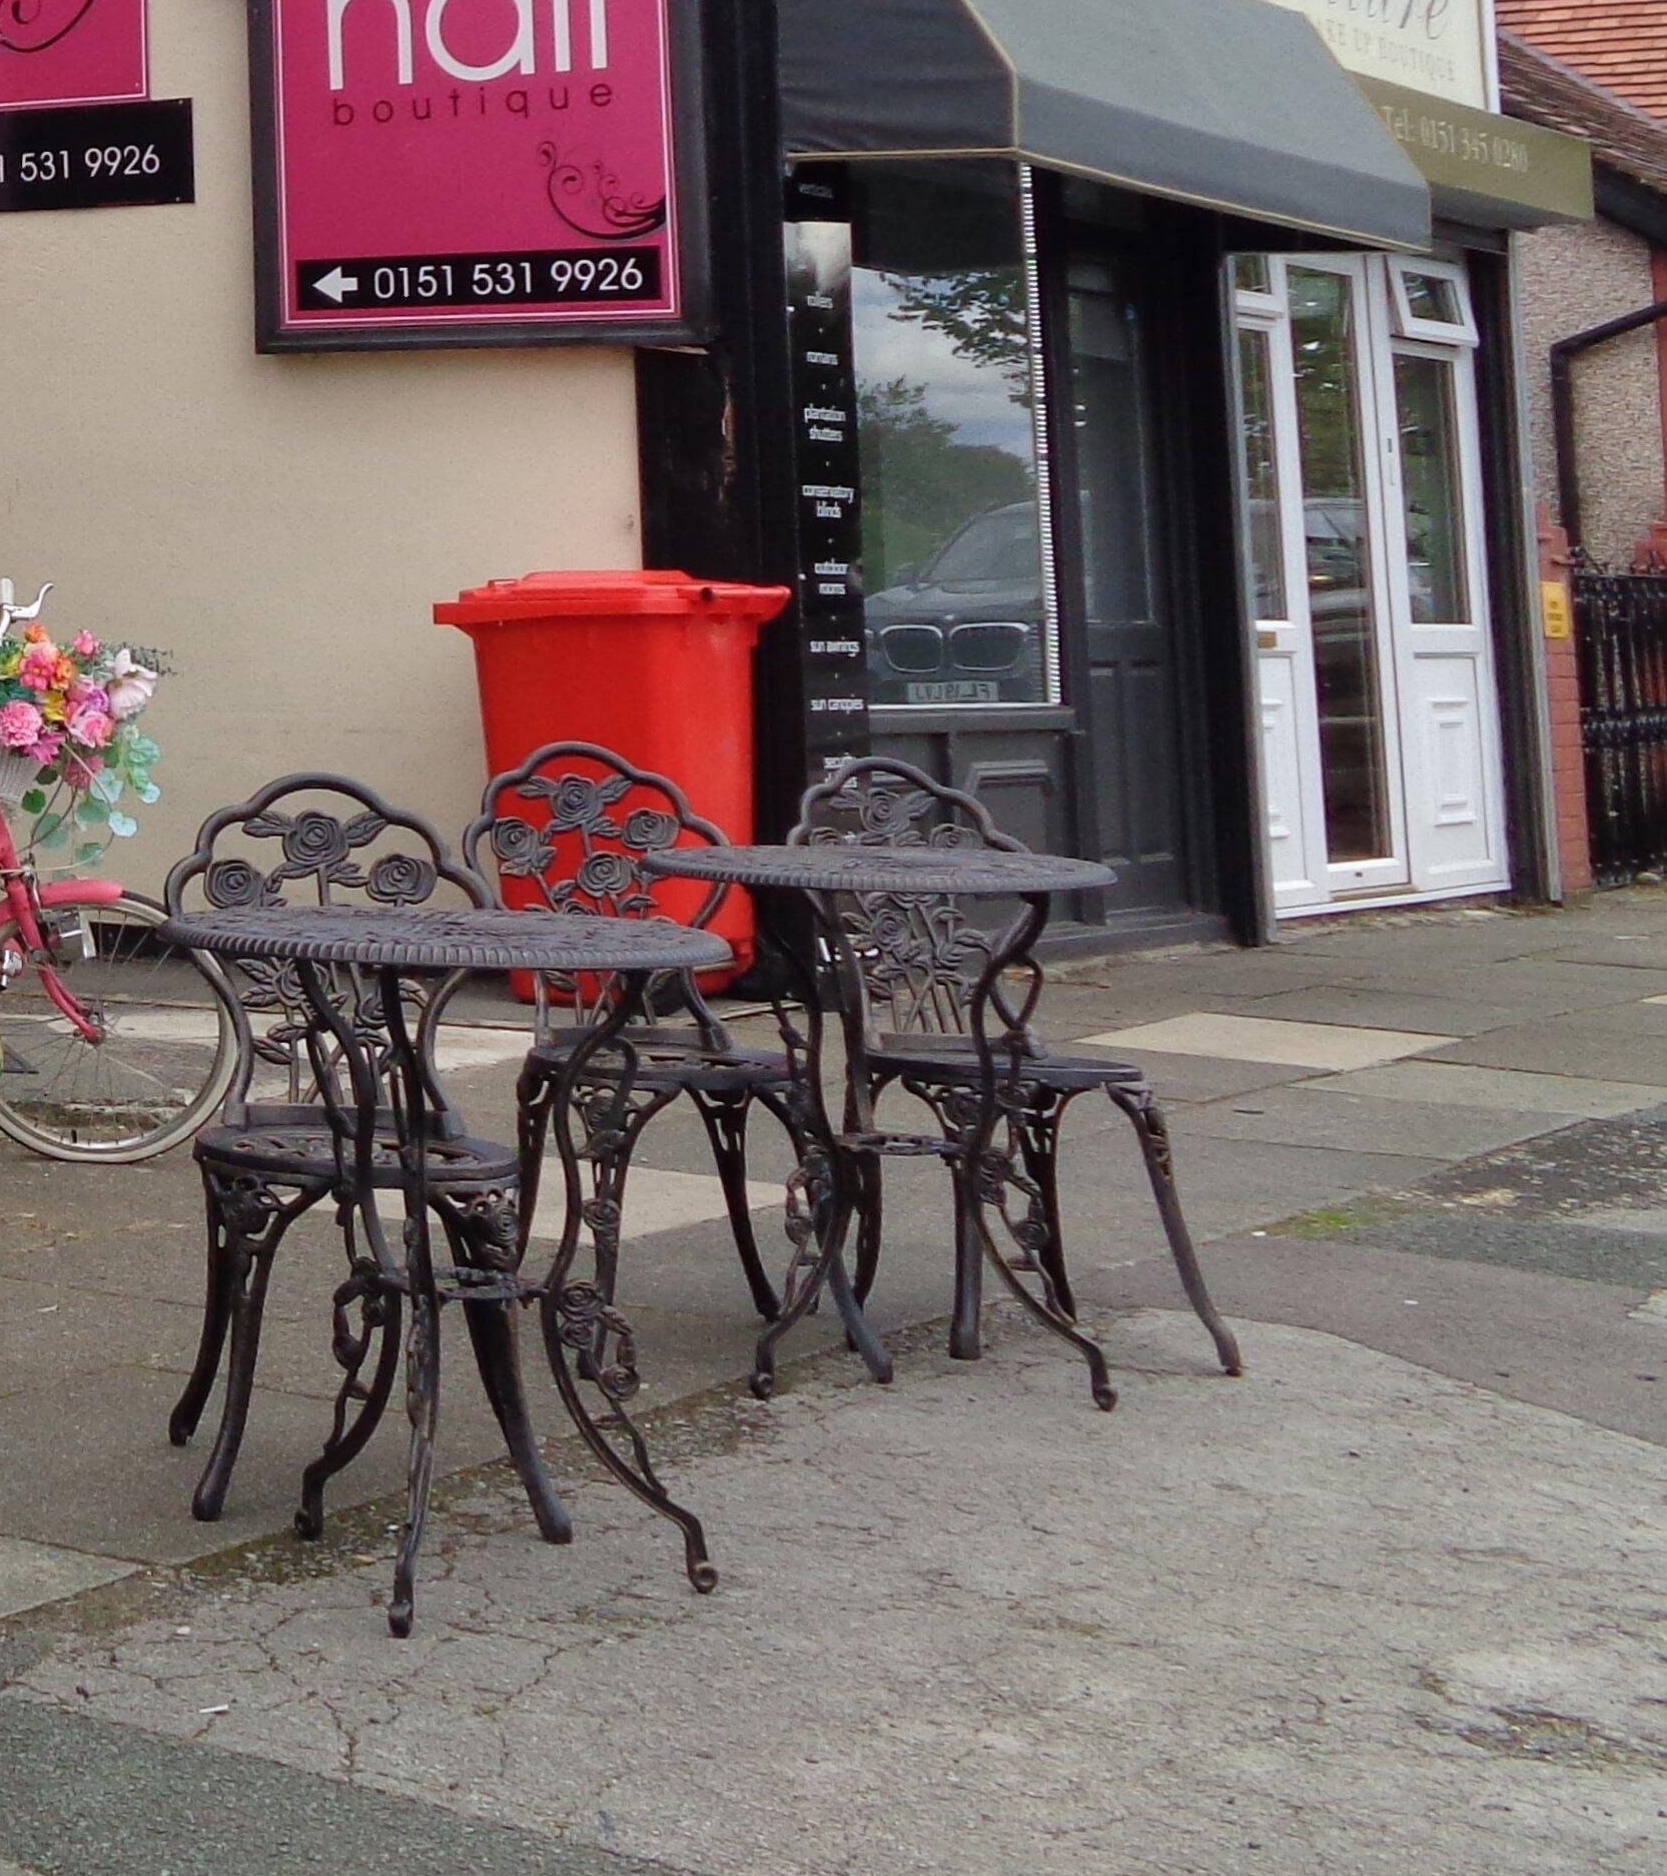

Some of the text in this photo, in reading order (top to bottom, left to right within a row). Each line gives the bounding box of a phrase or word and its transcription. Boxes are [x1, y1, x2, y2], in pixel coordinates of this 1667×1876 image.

[333, 83, 612, 125] boutique
[20, 150, 69, 180] 531
[85, 145, 159, 177] 9926
[374, 257, 642, 299] 0151 531 9926
